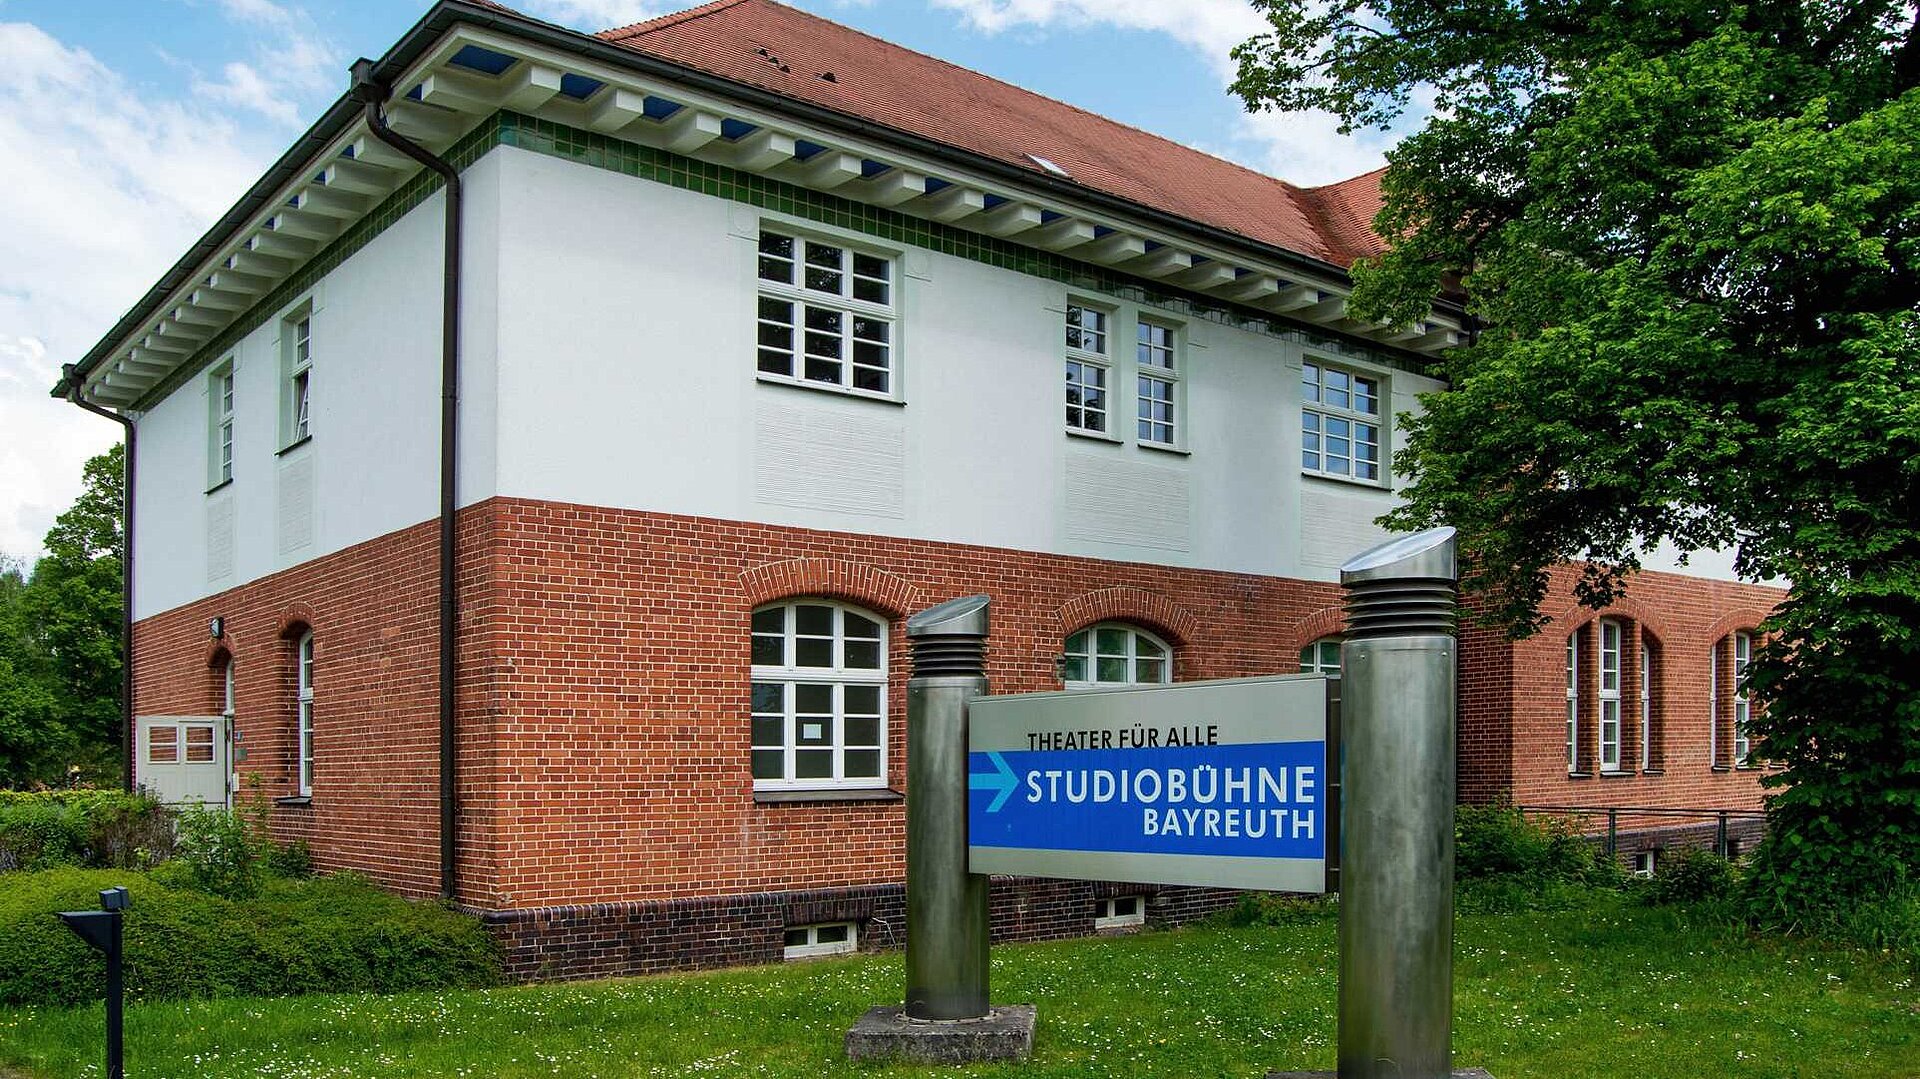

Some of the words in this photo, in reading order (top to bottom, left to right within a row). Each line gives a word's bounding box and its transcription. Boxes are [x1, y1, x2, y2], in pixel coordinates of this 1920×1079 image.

[1028, 729, 1112, 751] THEATER
[1120, 723, 1159, 749] FÜR
[1165, 725, 1218, 747] ALLE
[1026, 764, 1315, 804] STUDIOBÜHNE
[1143, 808, 1315, 839] BAYREUTH
